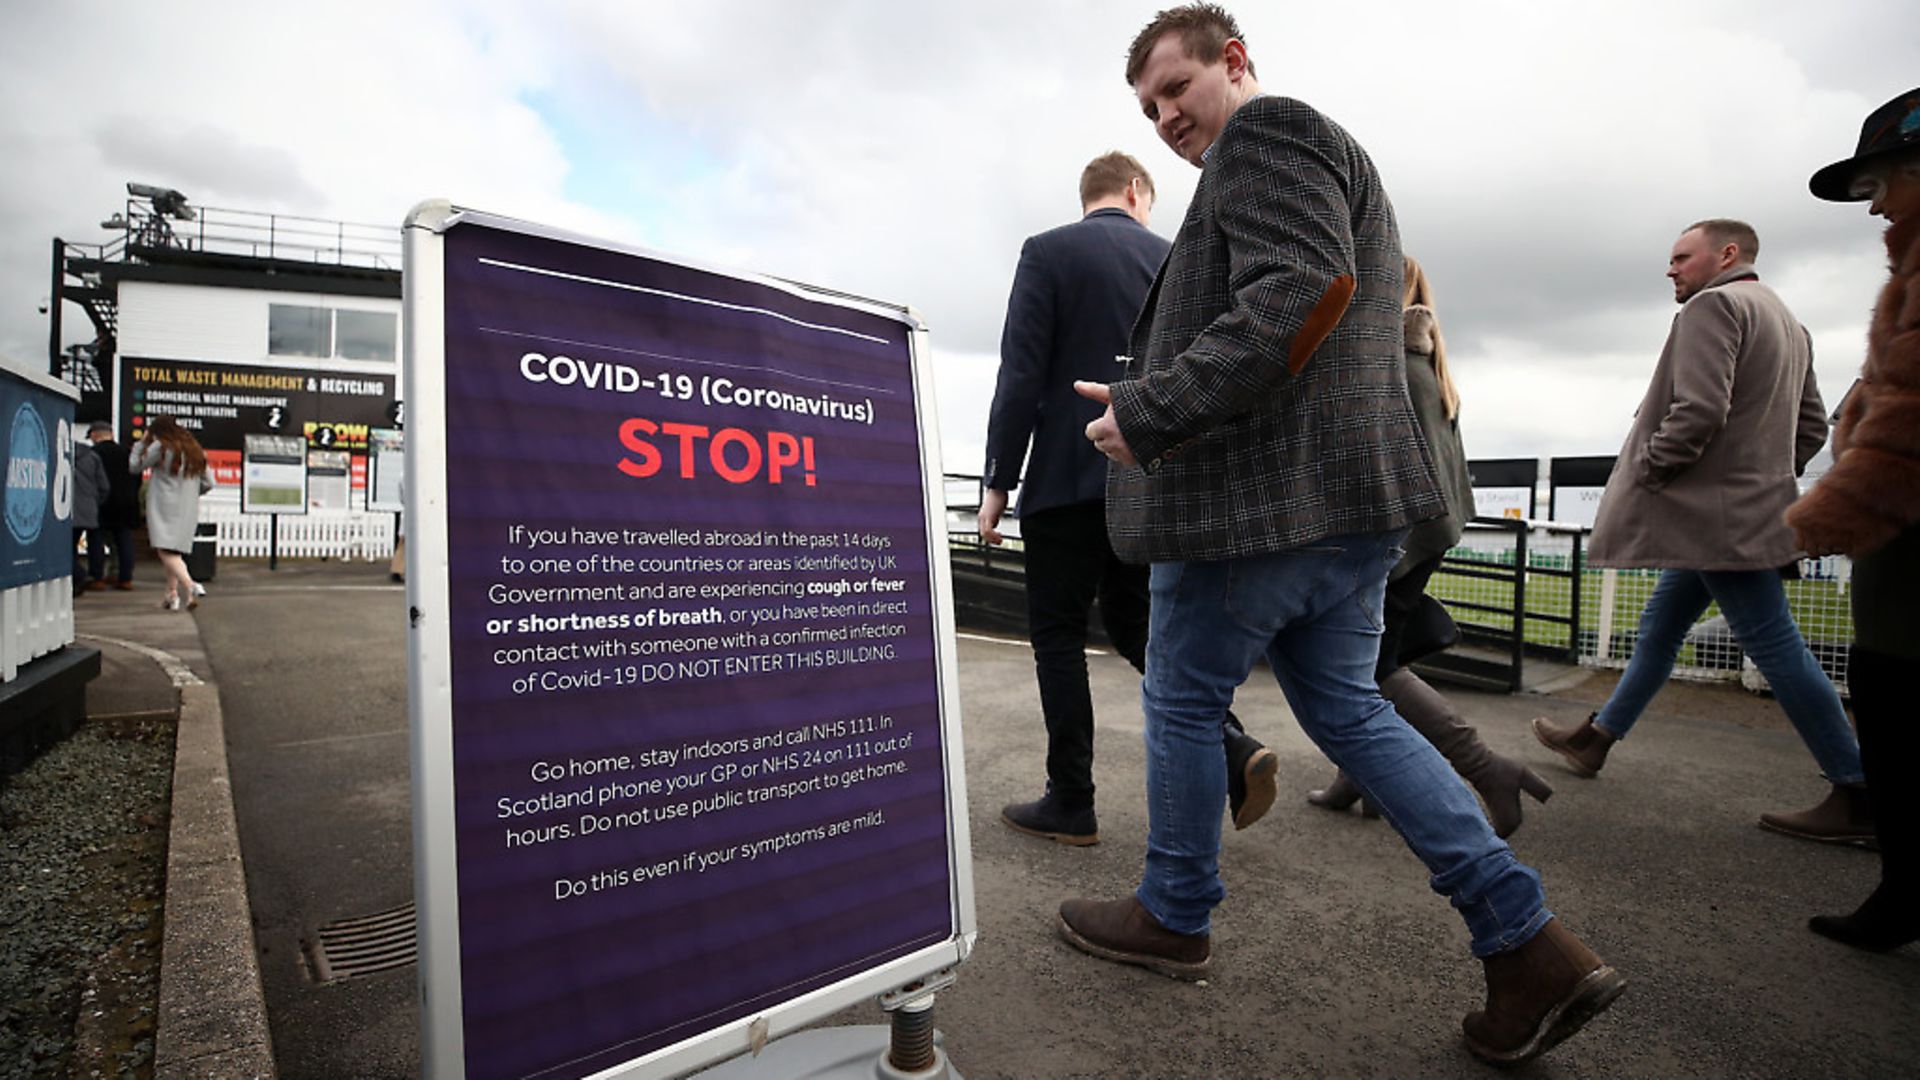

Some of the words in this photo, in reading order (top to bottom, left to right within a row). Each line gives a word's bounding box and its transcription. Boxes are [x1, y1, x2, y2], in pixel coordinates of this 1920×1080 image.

[134, 367, 172, 383] TOTAL
[176, 369, 217, 385] WASTE
[221, 372, 303, 390] MANAGEMENT
[307, 378, 317, 392] &
[321, 378, 384, 396] RECYCLING
[146, 390, 201, 403] COMMERCIAL
[232, 395, 287, 407] MANAGEMENT
[520, 352, 693, 399] COVID-19
[701, 376, 874, 425] (Coronavirus)
[617, 417, 817, 487] STOP!
[508, 525, 525, 544] If
[527, 528, 567, 549] you
[570, 526, 619, 545] have
[622, 528, 701, 547] travelled
[703, 529, 762, 547] abroad
[763, 530, 779, 546] in
[782, 530, 809, 547] the
[810, 533, 841, 549] past
[843, 533, 860, 546] 14
[861, 533, 892, 551] days
[501, 555, 526, 574] to
[529, 558, 572, 574] one
[576, 553, 600, 573] of
[601, 554, 635, 573] the
[638, 555, 724, 573] countries
[726, 558, 745, 571] or
[748, 557, 792, 571] areas
[794, 553, 858, 570] identified
[860, 554, 876, 573] by
[878, 555, 897, 570] UK
[488, 583, 625, 605] Government
[628, 582, 665, 600] and
[667, 582, 697, 600] are
[700, 579, 805, 600] experiencing
[807, 578, 851, 597] cough
[853, 580, 869, 593] or
[870, 576, 906, 592] fever
[486, 617, 513, 634] or
[517, 611, 630, 634] shortness
[634, 607, 657, 627] of
[729, 609, 748, 622] or
[750, 606, 781, 627] you
[782, 603, 819, 620] have
[821, 602, 856, 617] been
[857, 600, 871, 615] in
[872, 599, 908, 616] direct
[493, 642, 580, 664] contact
[582, 637, 627, 658] with
[630, 636, 719, 655] someone
[720, 631, 757, 649] with
[759, 634, 769, 647] a
[772, 625, 848, 645] confirmed
[850, 622, 907, 640] infection
[512, 672, 538, 694] of
[540, 665, 638, 692] Covid-19
[641, 661, 676, 683] DO
[678, 657, 721, 680] NOT
[724, 653, 784, 676] ENTER
[786, 648, 824, 670] THIS
[531, 761, 566, 783] Go
[639, 747, 680, 768] stay
[682, 738, 749, 761] indoors
[752, 729, 783, 751] and
[785, 725, 811, 745] call
[812, 720, 847, 741] NHS
[880, 714, 893, 729] In
[497, 785, 594, 818] Scotland
[598, 780, 663, 808] phone
[666, 772, 708, 796] your
[710, 762, 739, 784] GP
[741, 764, 760, 779] or
[762, 752, 800, 775] NHS
[802, 751, 823, 769] 24
[824, 748, 843, 764] on
[846, 742, 871, 760] 111
[874, 740, 898, 755] out
[899, 732, 914, 750] of
[506, 822, 577, 849] hours.
[580, 814, 612, 836] Do
[615, 806, 652, 829] not
[653, 801, 690, 823] use
[692, 790, 744, 818] public
[746, 777, 822, 804] transport
[823, 774, 840, 789] to
[841, 769, 866, 789] get
[867, 760, 909, 779] home.
[555, 878, 588, 900] Do
[591, 869, 630, 893] this
[632, 857, 681, 884] even
[682, 851, 697, 871] if
[697, 845, 738, 875] your
[741, 826, 826, 859] symptoms
[827, 822, 852, 838] are
[853, 810, 886, 830] mild.
